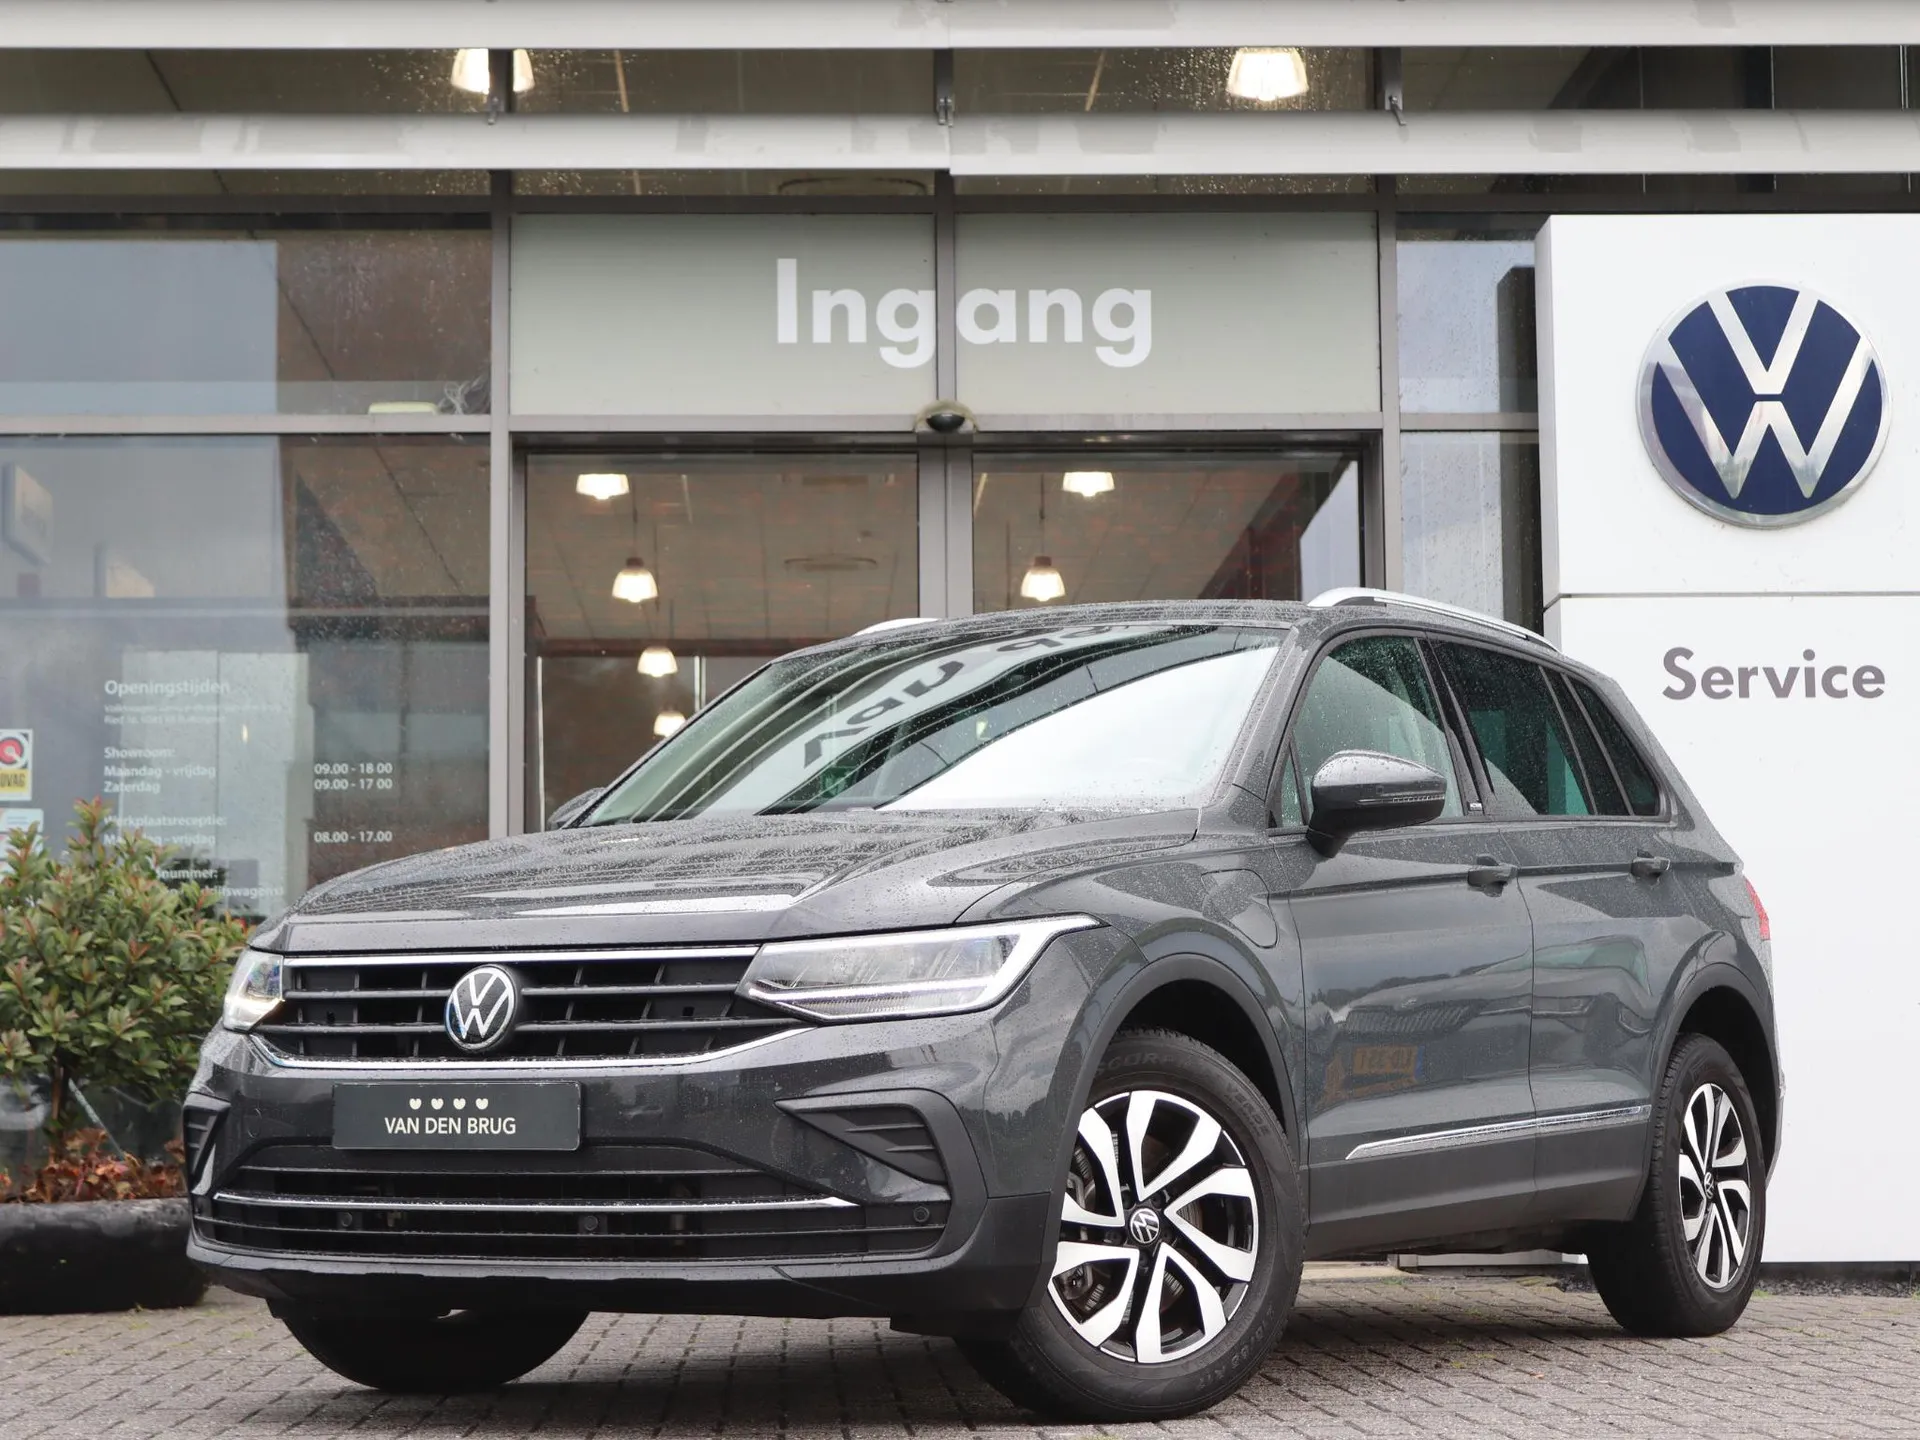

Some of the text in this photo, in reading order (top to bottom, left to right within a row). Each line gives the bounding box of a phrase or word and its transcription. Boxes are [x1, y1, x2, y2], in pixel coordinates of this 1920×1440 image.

[776, 257, 1153, 369] Ingang
[1662, 646, 1887, 701] Service
[104, 678, 230, 698] Openingstijden
[104, 746, 176, 759] Showroom:
[104, 765, 162, 779] Maandag
[172, 764, 216, 778] vrijdag
[314, 763, 349, 775] 09.00
[0, 772, 26, 788] OVAG
[104, 781, 160, 794] Zaterdag
[314, 778, 349, 790] 09.00
[104, 814, 227, 828] Werkplaatsreceptie:
[172, 834, 216, 847] vrijdag
[314, 831, 349, 843] 08.00
[360, 830, 393, 843] 17.00
[384, 1117, 516, 1134] VAN DEN BRUG
